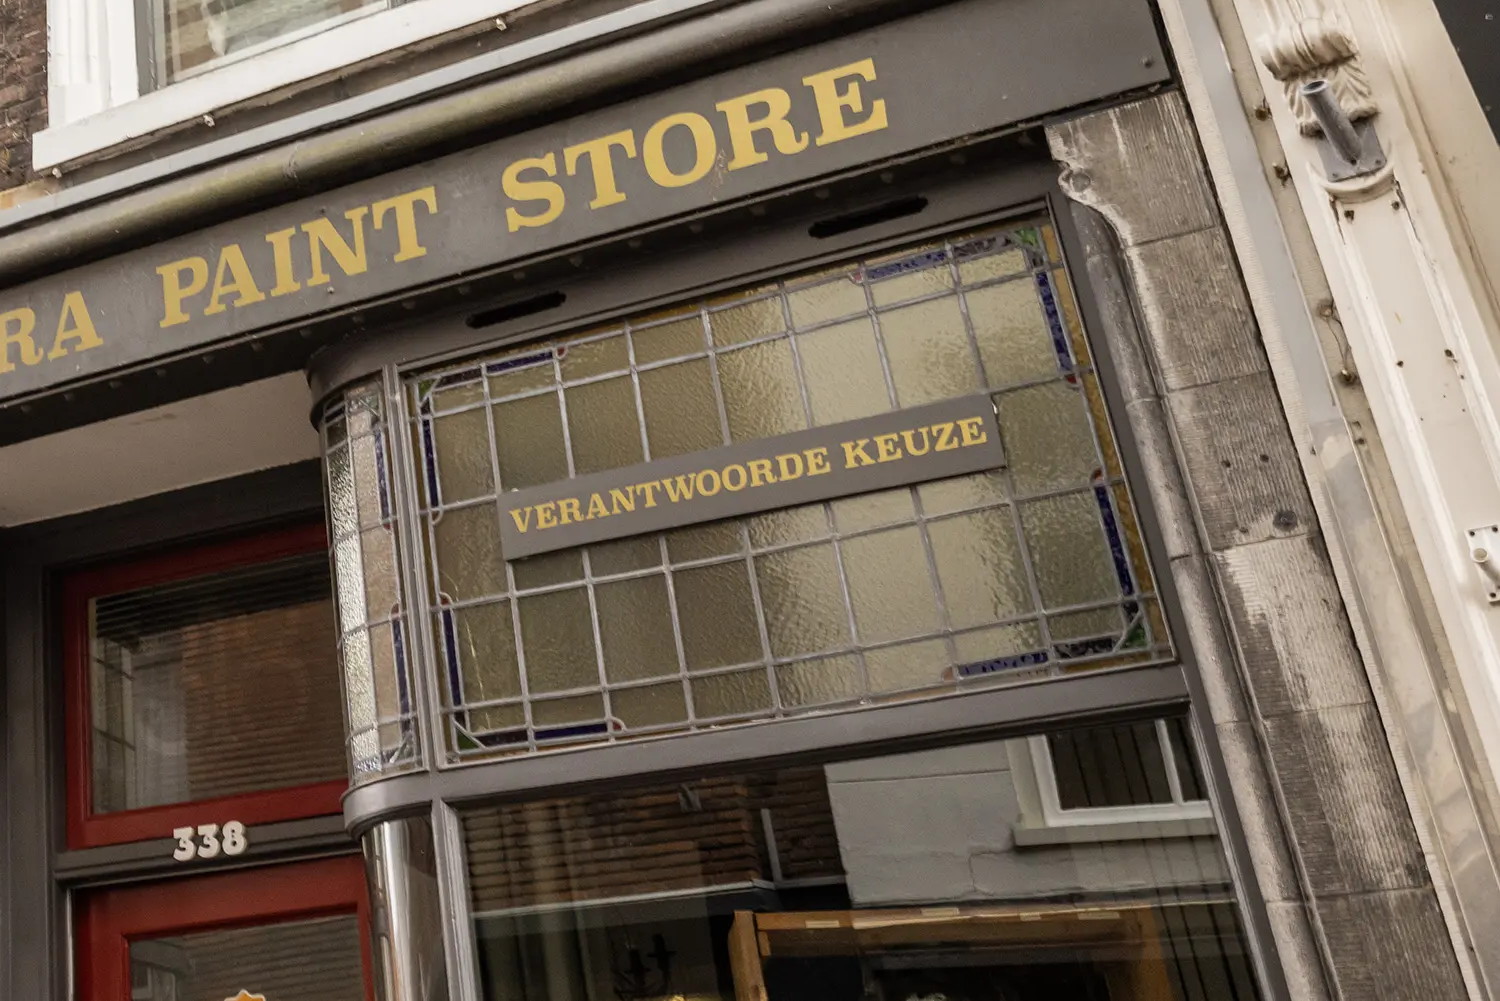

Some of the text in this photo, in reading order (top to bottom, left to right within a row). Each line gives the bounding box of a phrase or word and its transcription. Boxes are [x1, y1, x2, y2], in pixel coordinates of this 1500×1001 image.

[156, 186, 438, 328] PAINT
[501, 57, 888, 232] STORE
[509, 416, 988, 533] VERANTWOORDE KEUZE
[173, 820, 247, 862] 338
